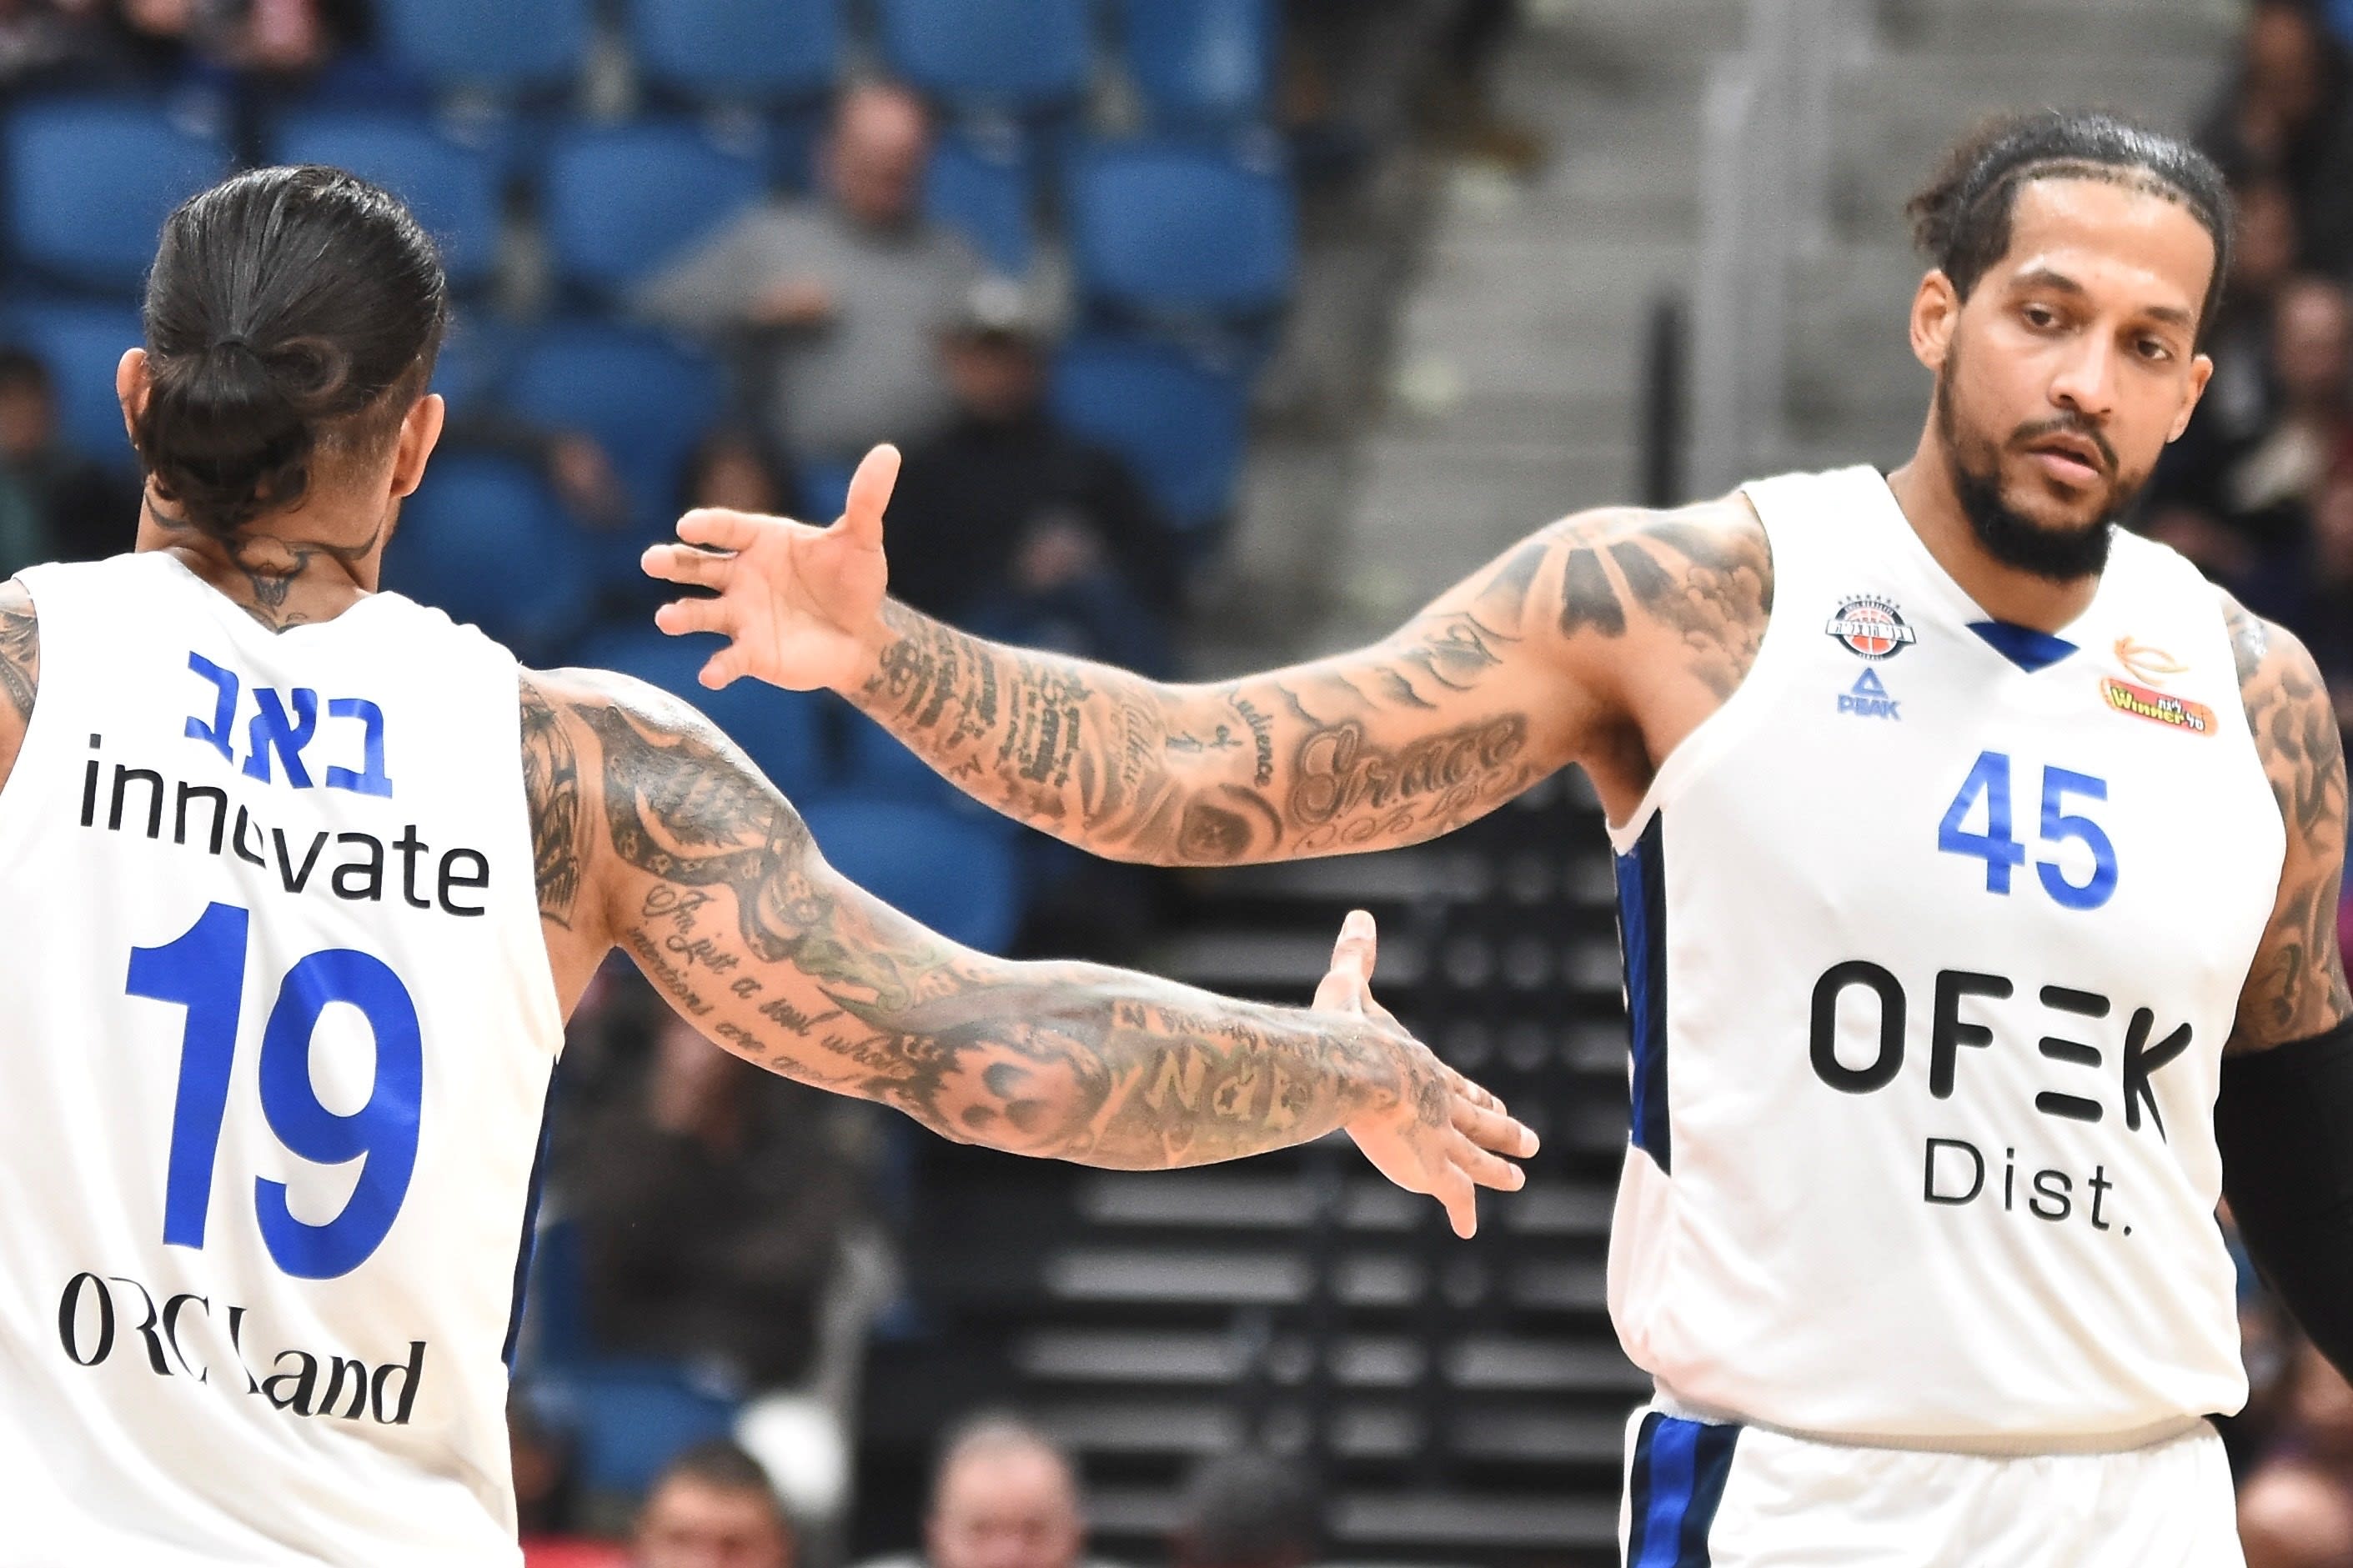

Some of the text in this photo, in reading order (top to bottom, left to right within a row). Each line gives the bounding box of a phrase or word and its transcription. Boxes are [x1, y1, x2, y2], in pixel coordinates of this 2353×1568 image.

[1837, 694, 1901, 722] PEAK
[2110, 685, 2185, 726] Winner
[80, 733, 490, 917] innovate
[1938, 749, 2119, 910] 45
[125, 900, 424, 1280] 19
[1809, 959, 2194, 1145] OFEK
[1924, 1136, 2132, 1236] Dist.
